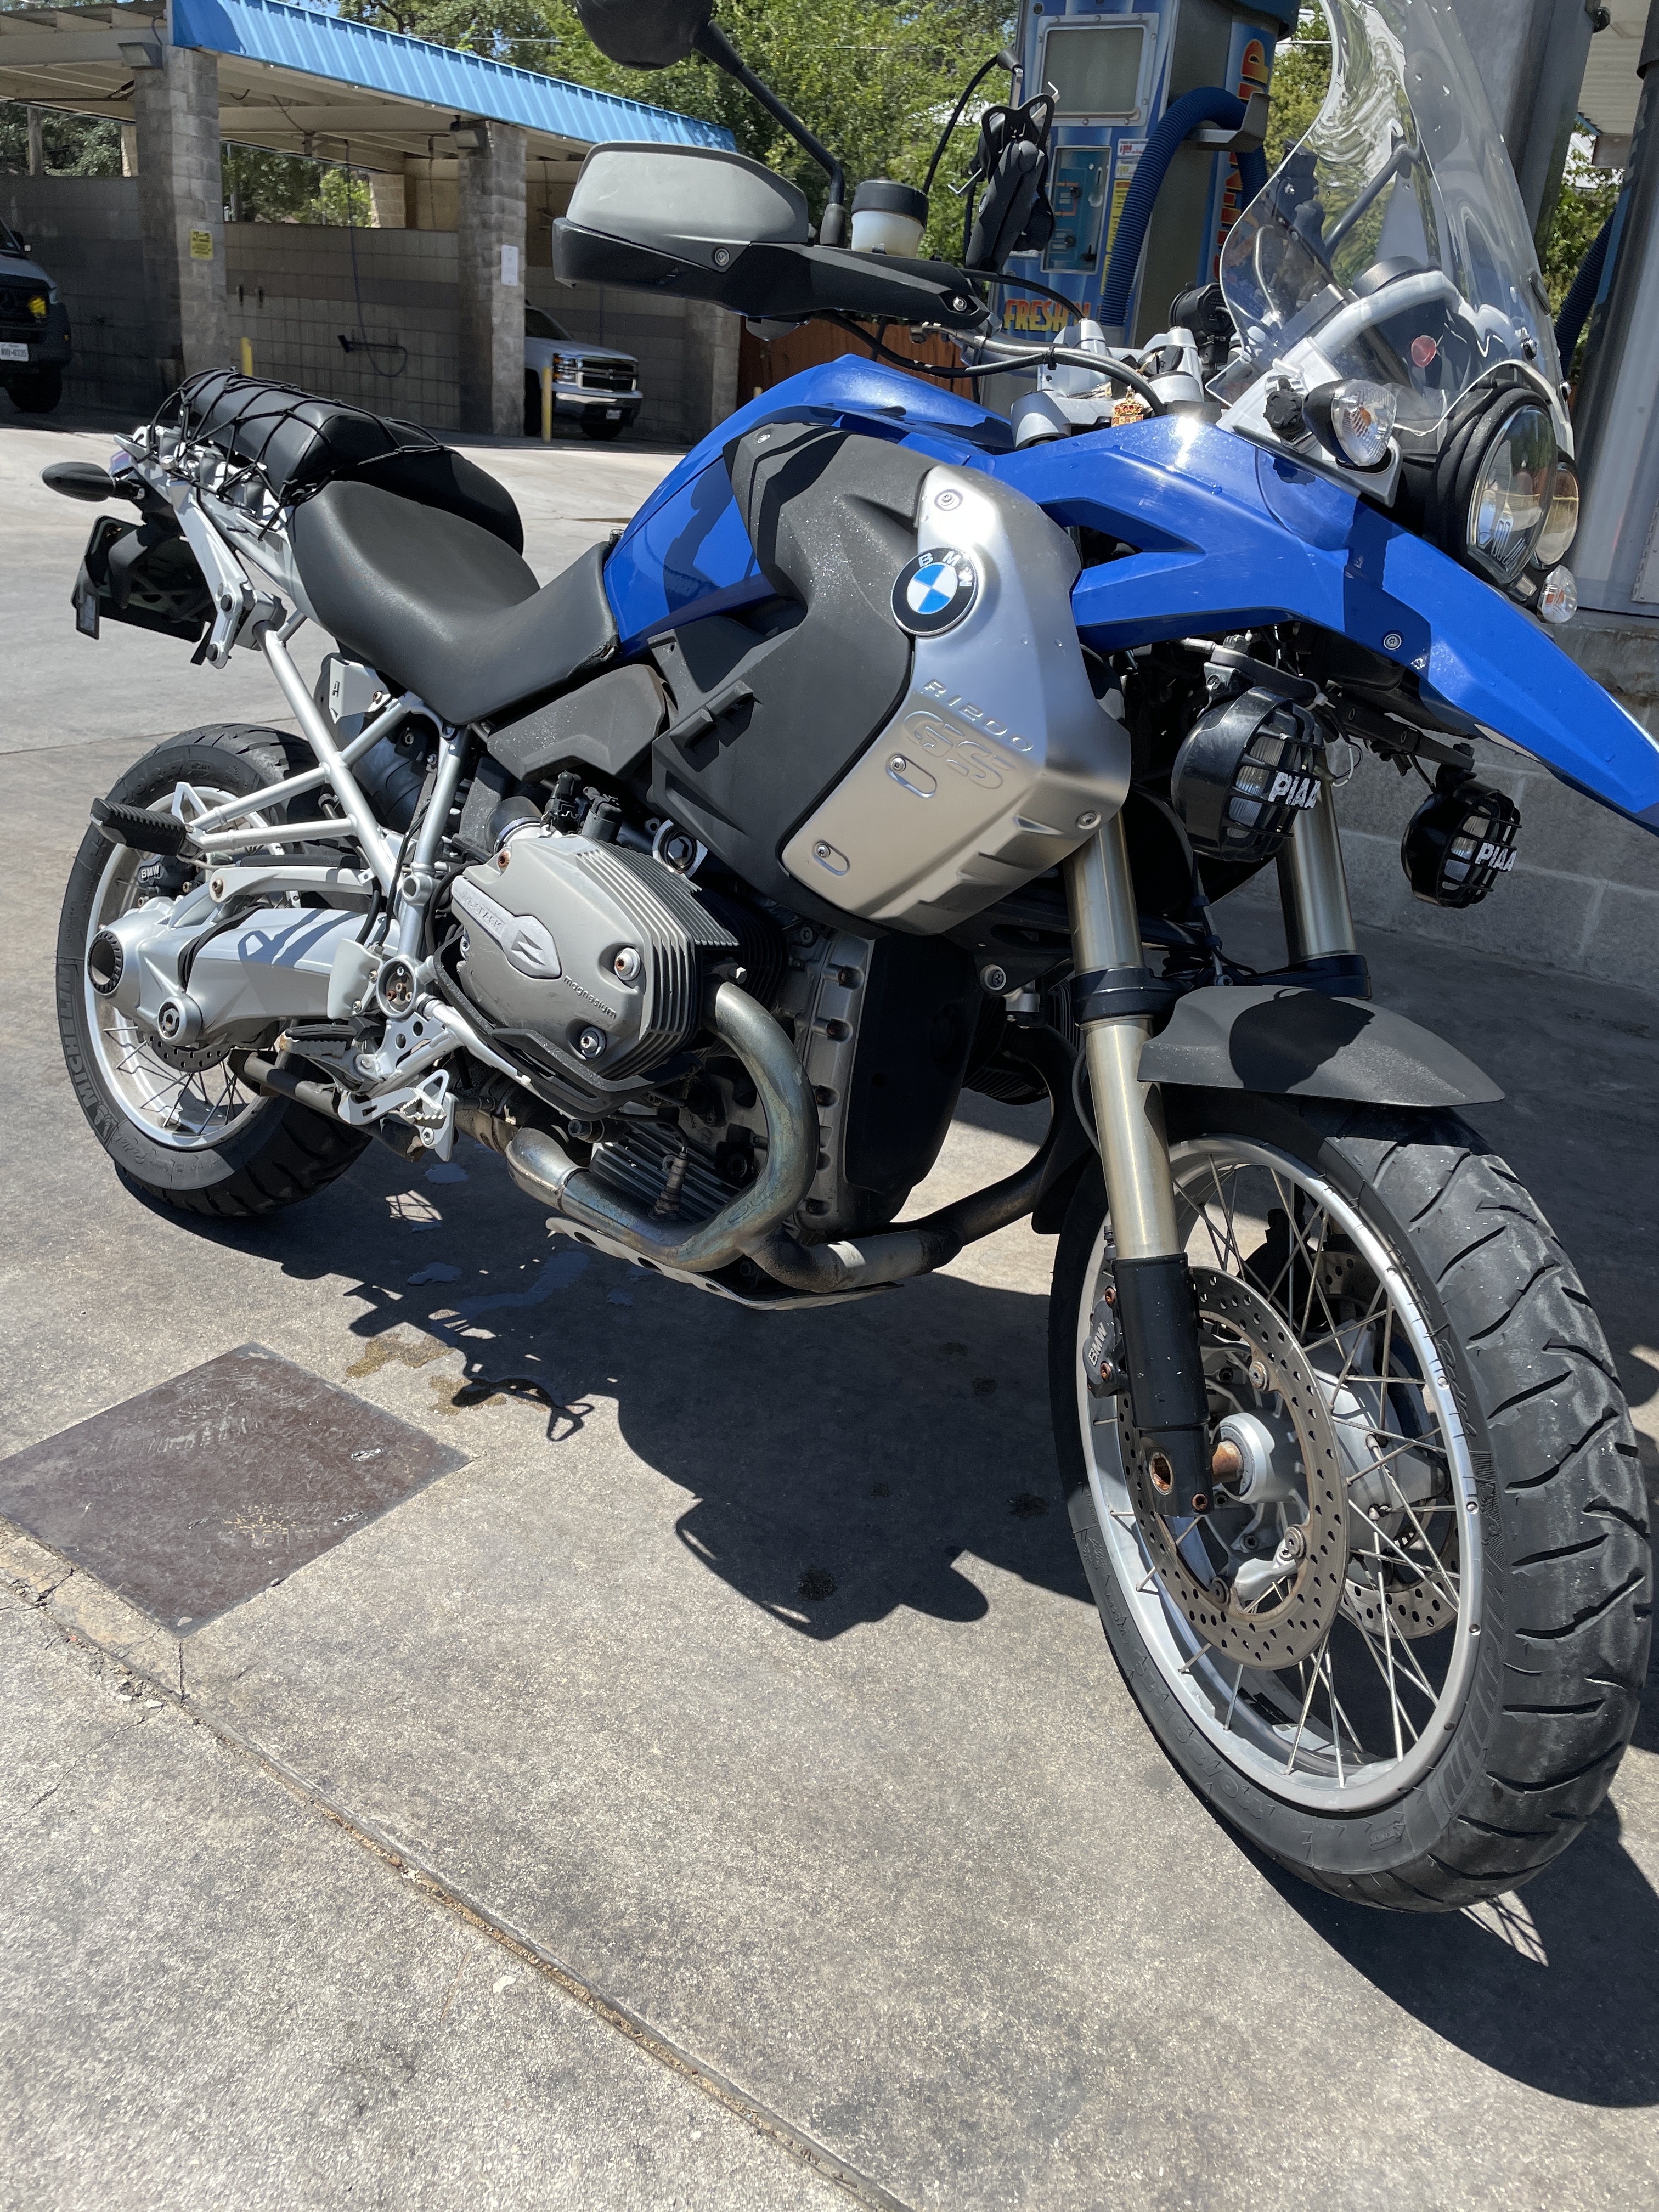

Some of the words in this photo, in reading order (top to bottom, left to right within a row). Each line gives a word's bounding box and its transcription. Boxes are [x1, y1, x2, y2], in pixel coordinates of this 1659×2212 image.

[918, 550, 973, 587] BMW
[924, 679, 1034, 752] R1200
[902, 710, 1016, 790] GS
[1268, 771, 1321, 809] PIAA
[141, 865, 160, 879] BMW
[1474, 842, 1517, 872] PIAA
[563, 975, 617, 1020] magnesium
[57, 965, 98, 1108] MICHELIN
[1088, 1322, 1108, 1367] BMW
